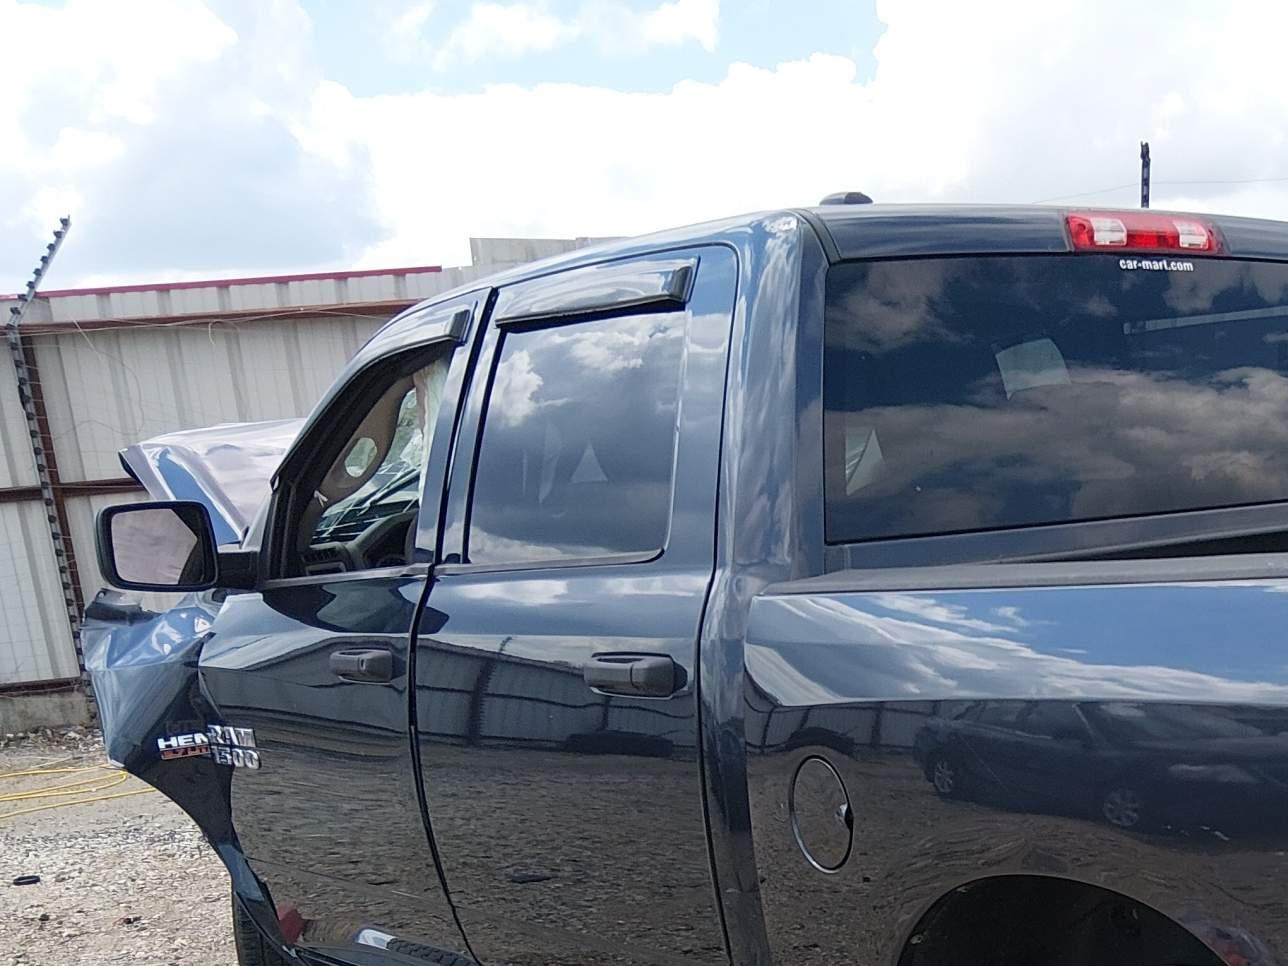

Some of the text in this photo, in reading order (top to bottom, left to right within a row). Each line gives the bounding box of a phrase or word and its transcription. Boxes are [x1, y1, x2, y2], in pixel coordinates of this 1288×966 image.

[1119, 259, 1194, 272] car-mart.com
[207, 724, 257, 748] RAM
[210, 745, 261, 770] 1500
